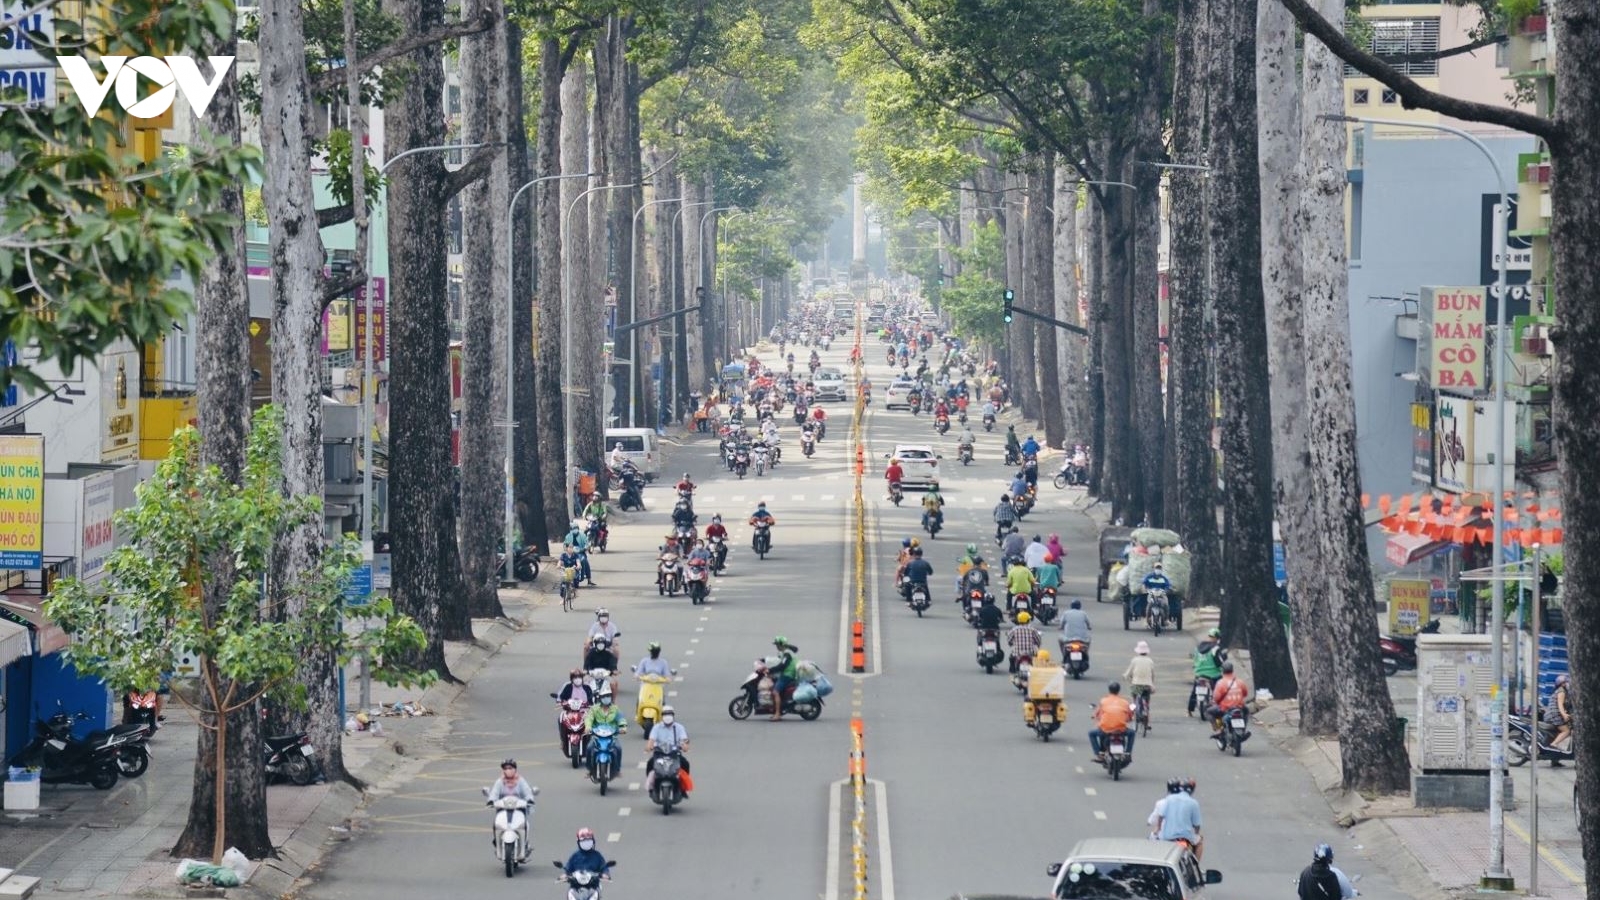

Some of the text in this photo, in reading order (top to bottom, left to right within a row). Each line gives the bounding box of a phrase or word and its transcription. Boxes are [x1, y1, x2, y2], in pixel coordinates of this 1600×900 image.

[1437, 290, 1482, 311] BÚN
[1434, 313, 1483, 339] MẮM
[1439, 343, 1477, 364] CÔ
[1438, 369, 1477, 387] BA
[0, 461, 40, 478] ÚN CHẢ
[16, 485, 35, 504] NỘI
[0, 509, 40, 527] ÚN ĐẬU
